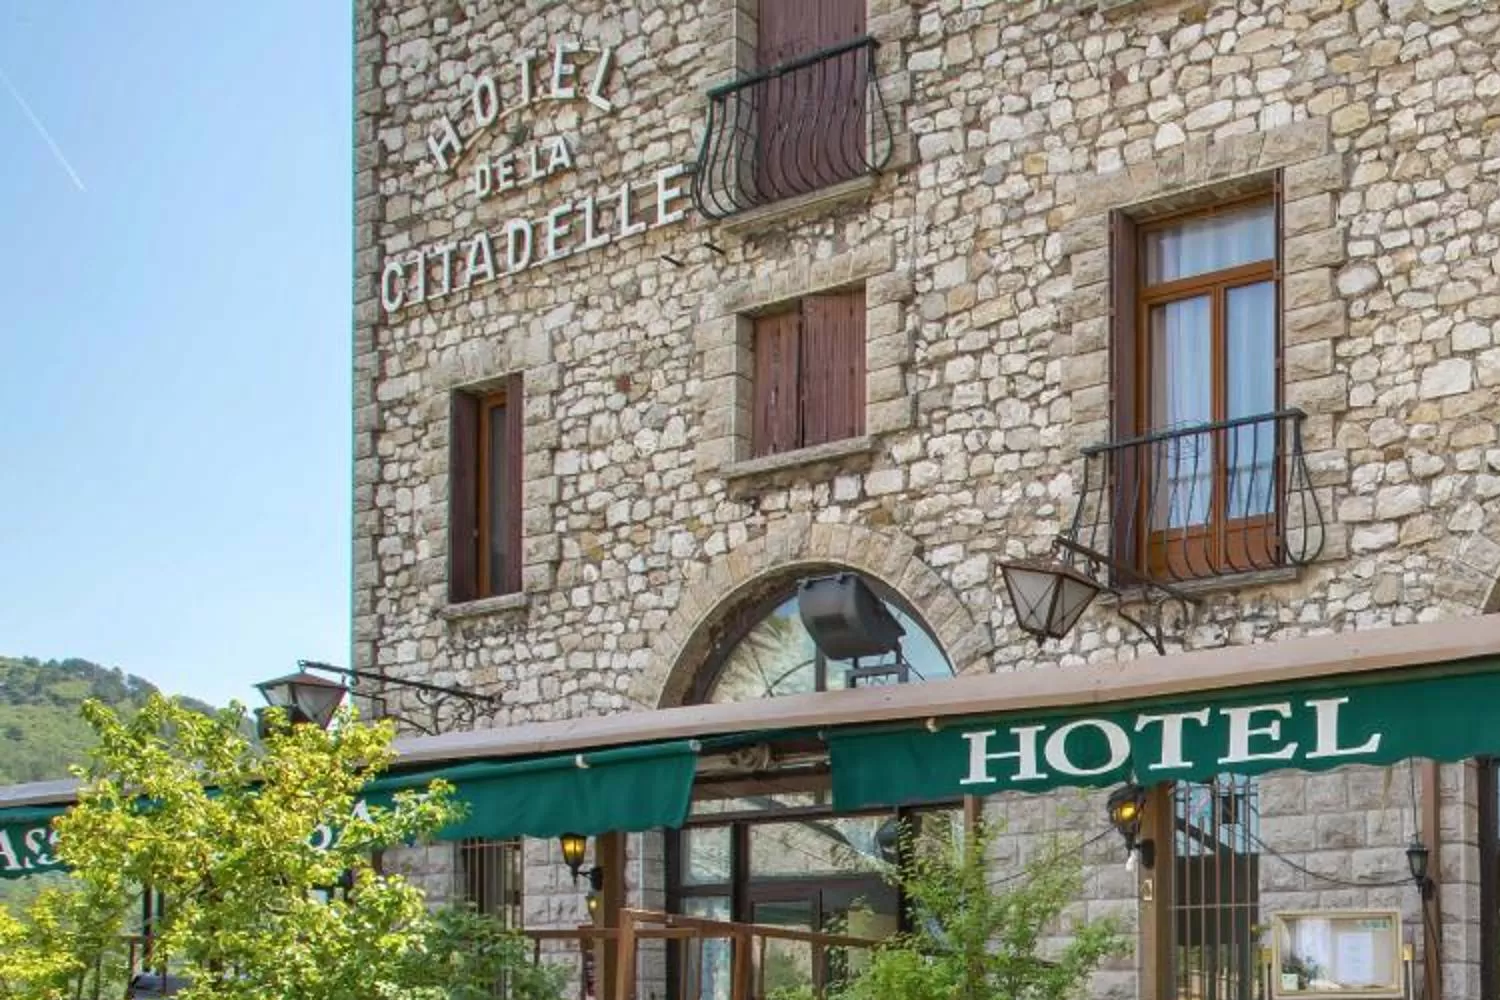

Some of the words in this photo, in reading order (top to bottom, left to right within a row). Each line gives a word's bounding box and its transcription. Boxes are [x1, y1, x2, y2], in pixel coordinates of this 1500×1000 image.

[427, 41, 612, 172] HOTEL
[475, 154, 515, 199] DE
[530, 137, 574, 179] LA
[381, 163, 688, 313] CITADELLE
[959, 696, 1382, 786] HOTEL
